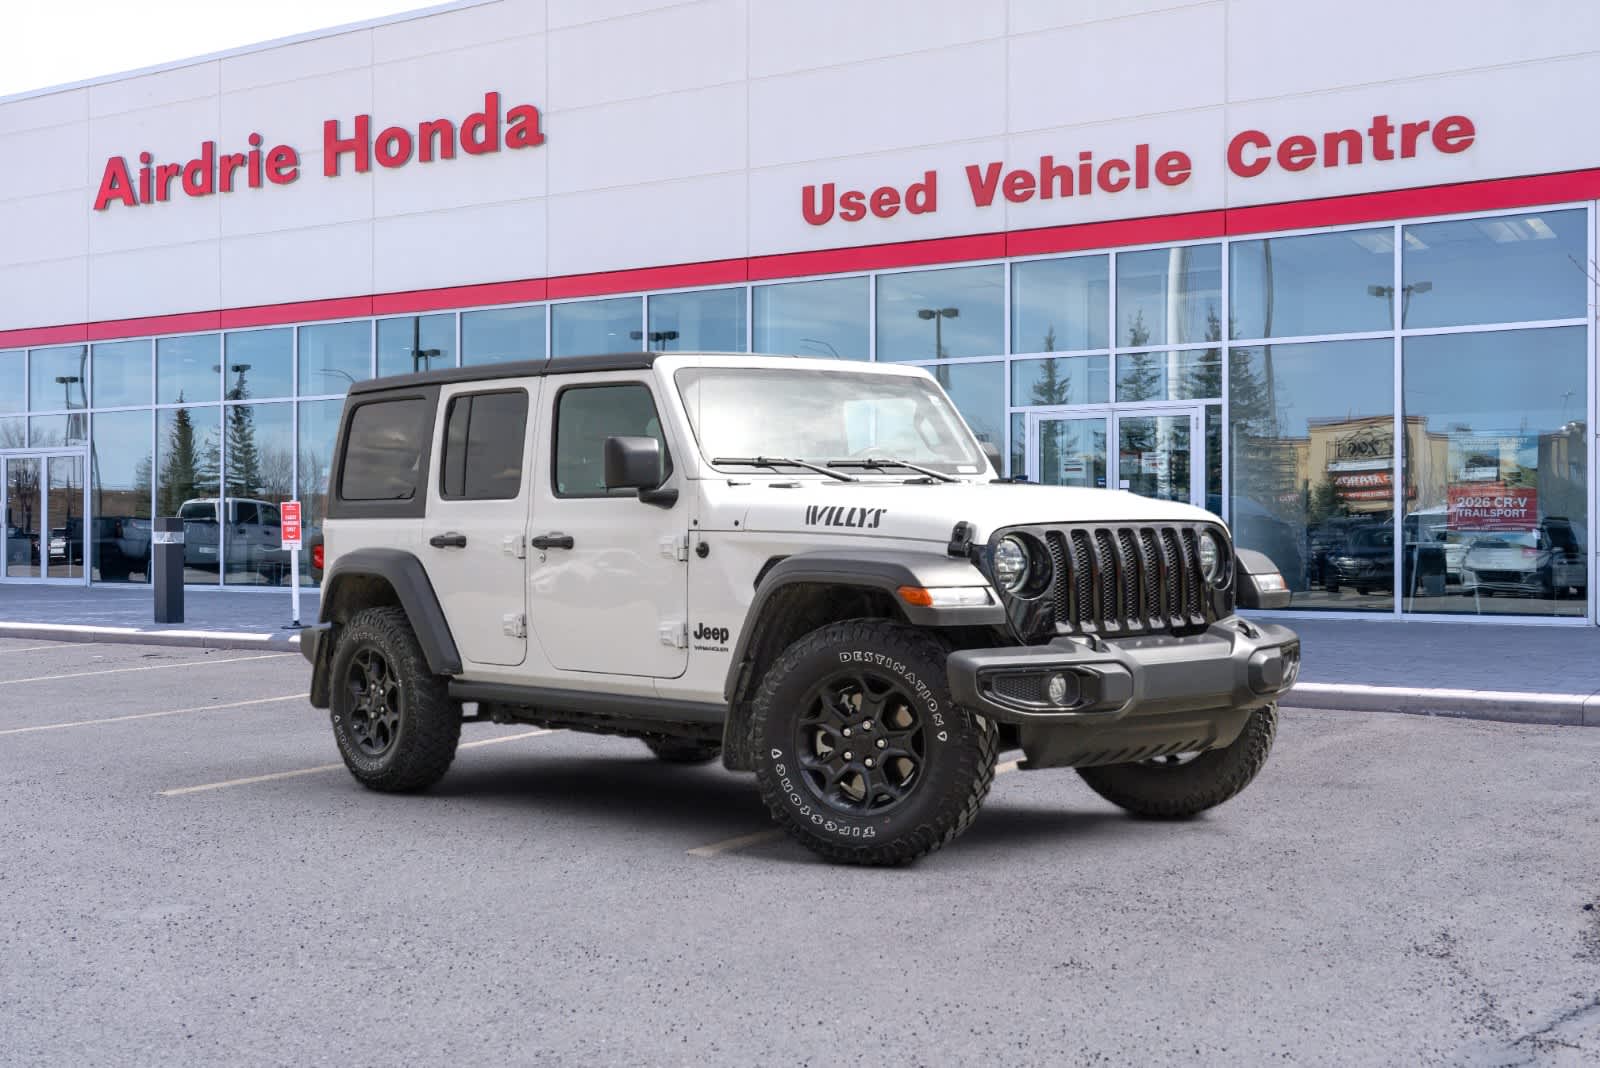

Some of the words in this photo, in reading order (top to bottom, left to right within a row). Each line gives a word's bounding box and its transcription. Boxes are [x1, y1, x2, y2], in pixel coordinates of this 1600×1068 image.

[94, 133, 298, 210] Airdrie
[323, 91, 546, 177] Honda
[802, 171, 937, 225] Used
[966, 143, 1192, 207] Vehicle
[1227, 115, 1476, 179] Centre
[805, 505, 888, 529] WILLYS
[1456, 496, 1491, 508] 2026
[1494, 496, 1528, 508] CR-V
[1457, 508, 1528, 518] TRAILSPORT
[693, 622, 730, 644] Jeep
[839, 650, 946, 728] DESTINATION
[776, 763, 876, 837] Firestone
